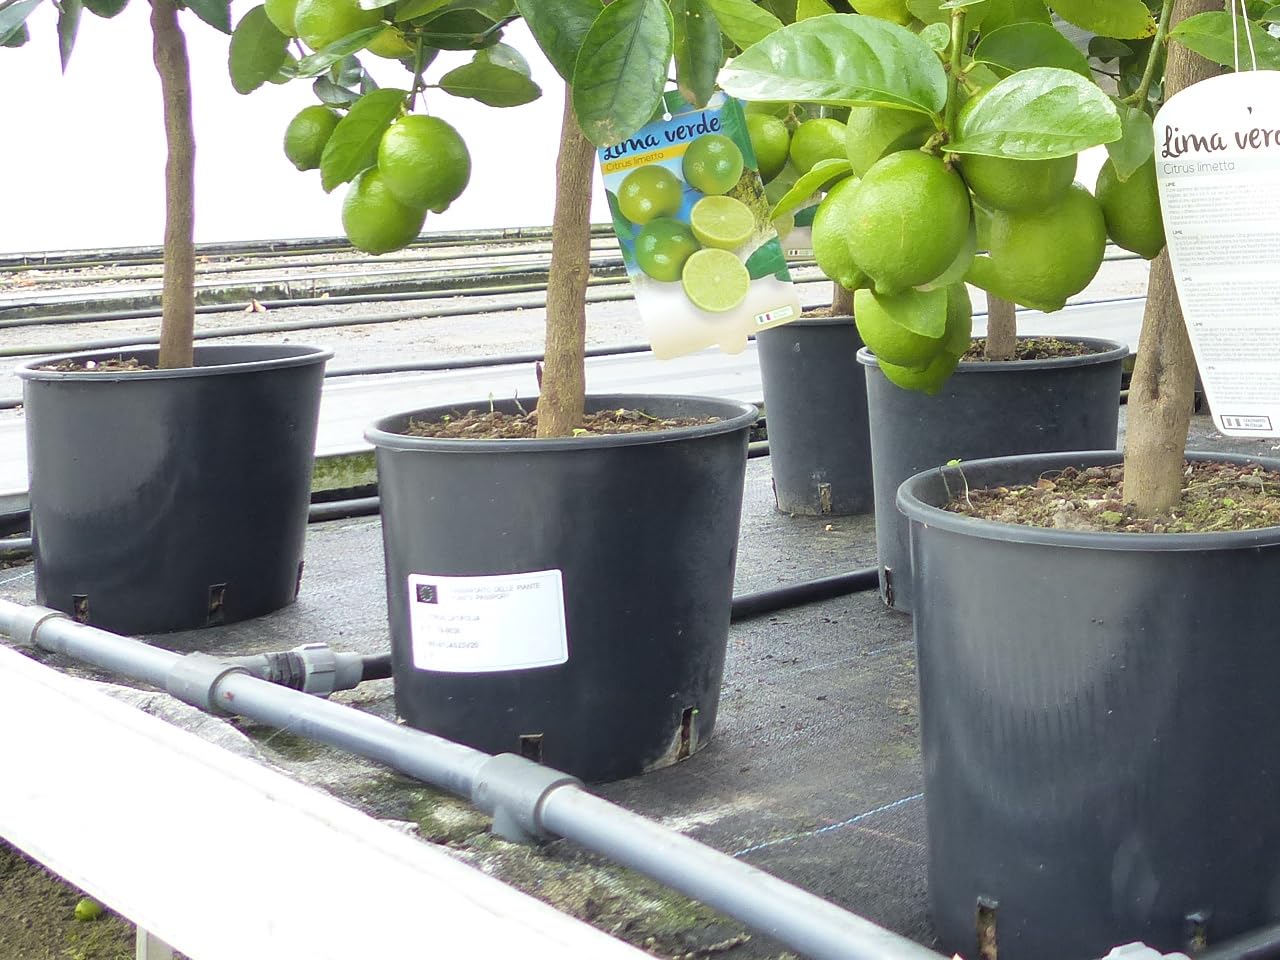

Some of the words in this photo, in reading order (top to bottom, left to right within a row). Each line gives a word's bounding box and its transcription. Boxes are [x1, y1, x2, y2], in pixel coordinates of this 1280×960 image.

[664, 112, 720, 143] verde
[1161, 125, 1228, 159] Lima
[1163, 162, 1195, 175] Citrus
[1196, 160, 1236, 173] limetta
